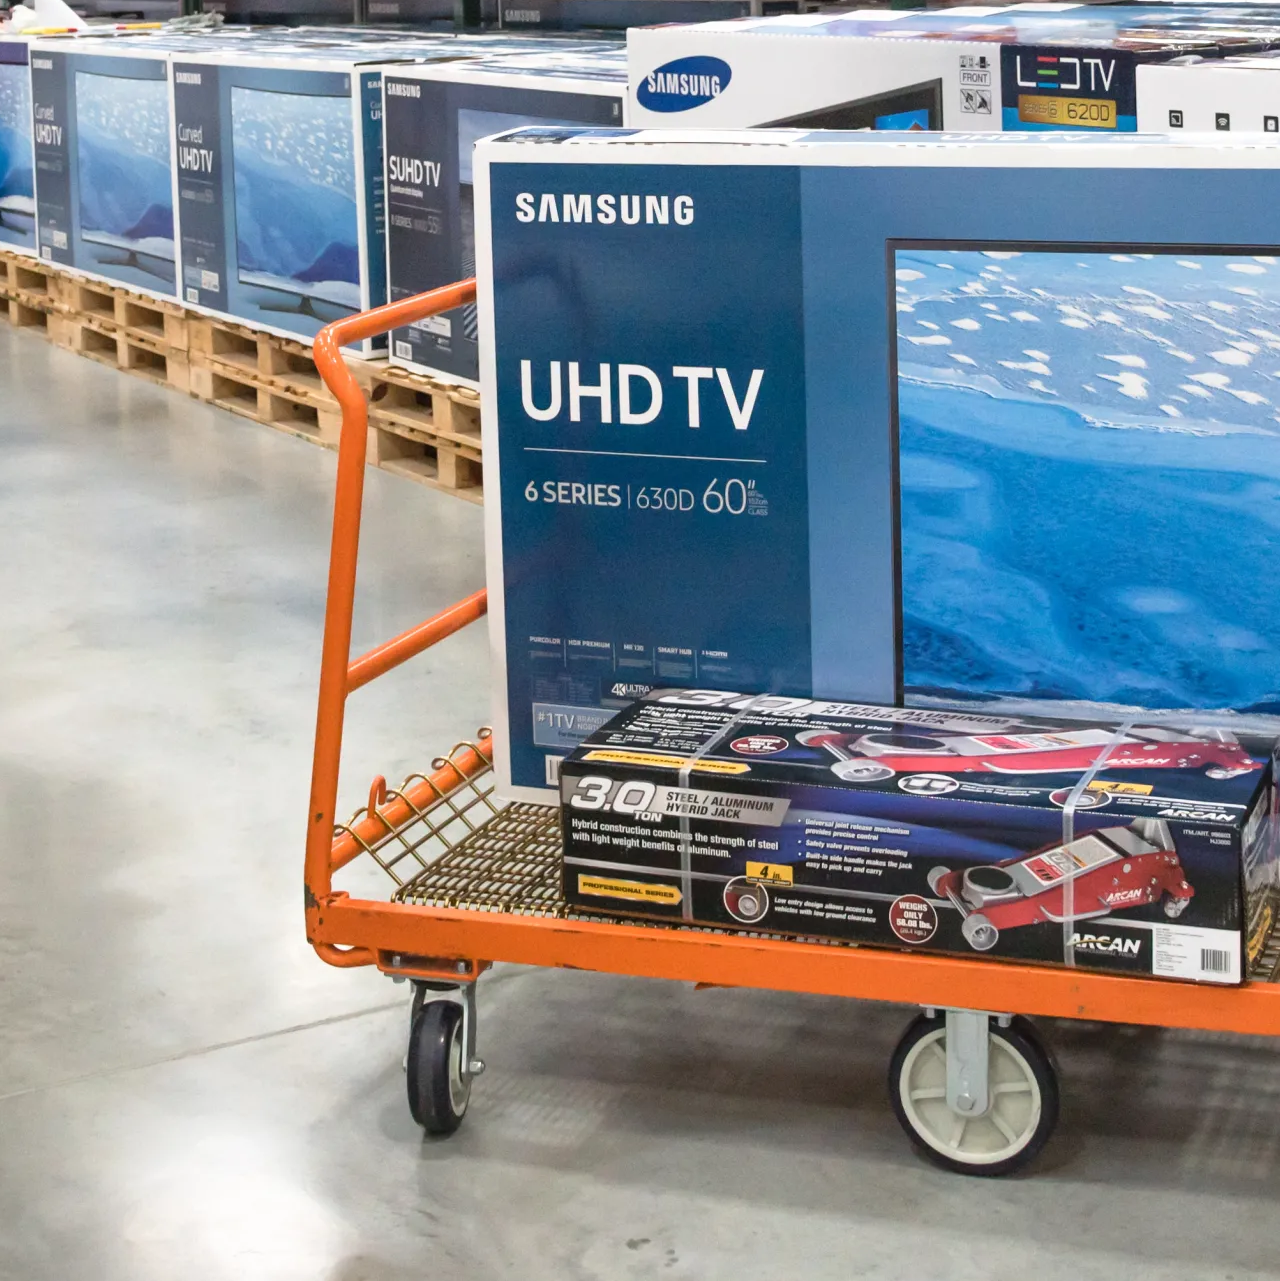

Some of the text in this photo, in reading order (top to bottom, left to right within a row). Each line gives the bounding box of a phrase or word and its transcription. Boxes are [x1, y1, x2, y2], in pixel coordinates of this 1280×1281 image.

[647, 71, 720, 98] SAMSUNG
[962, 72, 988, 84] FRONT
[1087, 58, 1116, 92] TV
[387, 82, 421, 98] SAMSUNG
[1066, 102, 1111, 123] 620D
[178, 123, 203, 143] Curved
[389, 155, 423, 185] SUHD
[515, 192, 695, 226] SAMSUNG
[520, 359, 764, 431] UHD TV
[524, 478, 756, 515] 6 SERIES 630D 60"
[570, 776, 657, 814] 3.0
[666, 791, 774, 812] STEEL ALUMINUM
[633, 810, 664, 823] TON
[666, 803, 741, 819] HYBRID JACK
[1157, 809, 1237, 822] ARCAN
[571, 818, 779, 851] Hybrid construction combines the strength steel
[572, 831, 732, 858] with light weight benefits aluminum.
[582, 881, 674, 899] PROFESSIONAL SERIES
[1106, 888, 1142, 902] ARCAN
[899, 901, 928, 912] WEIGHS
[903, 910, 923, 920] ONLY
[1070, 932, 1142, 954] ARCAN
